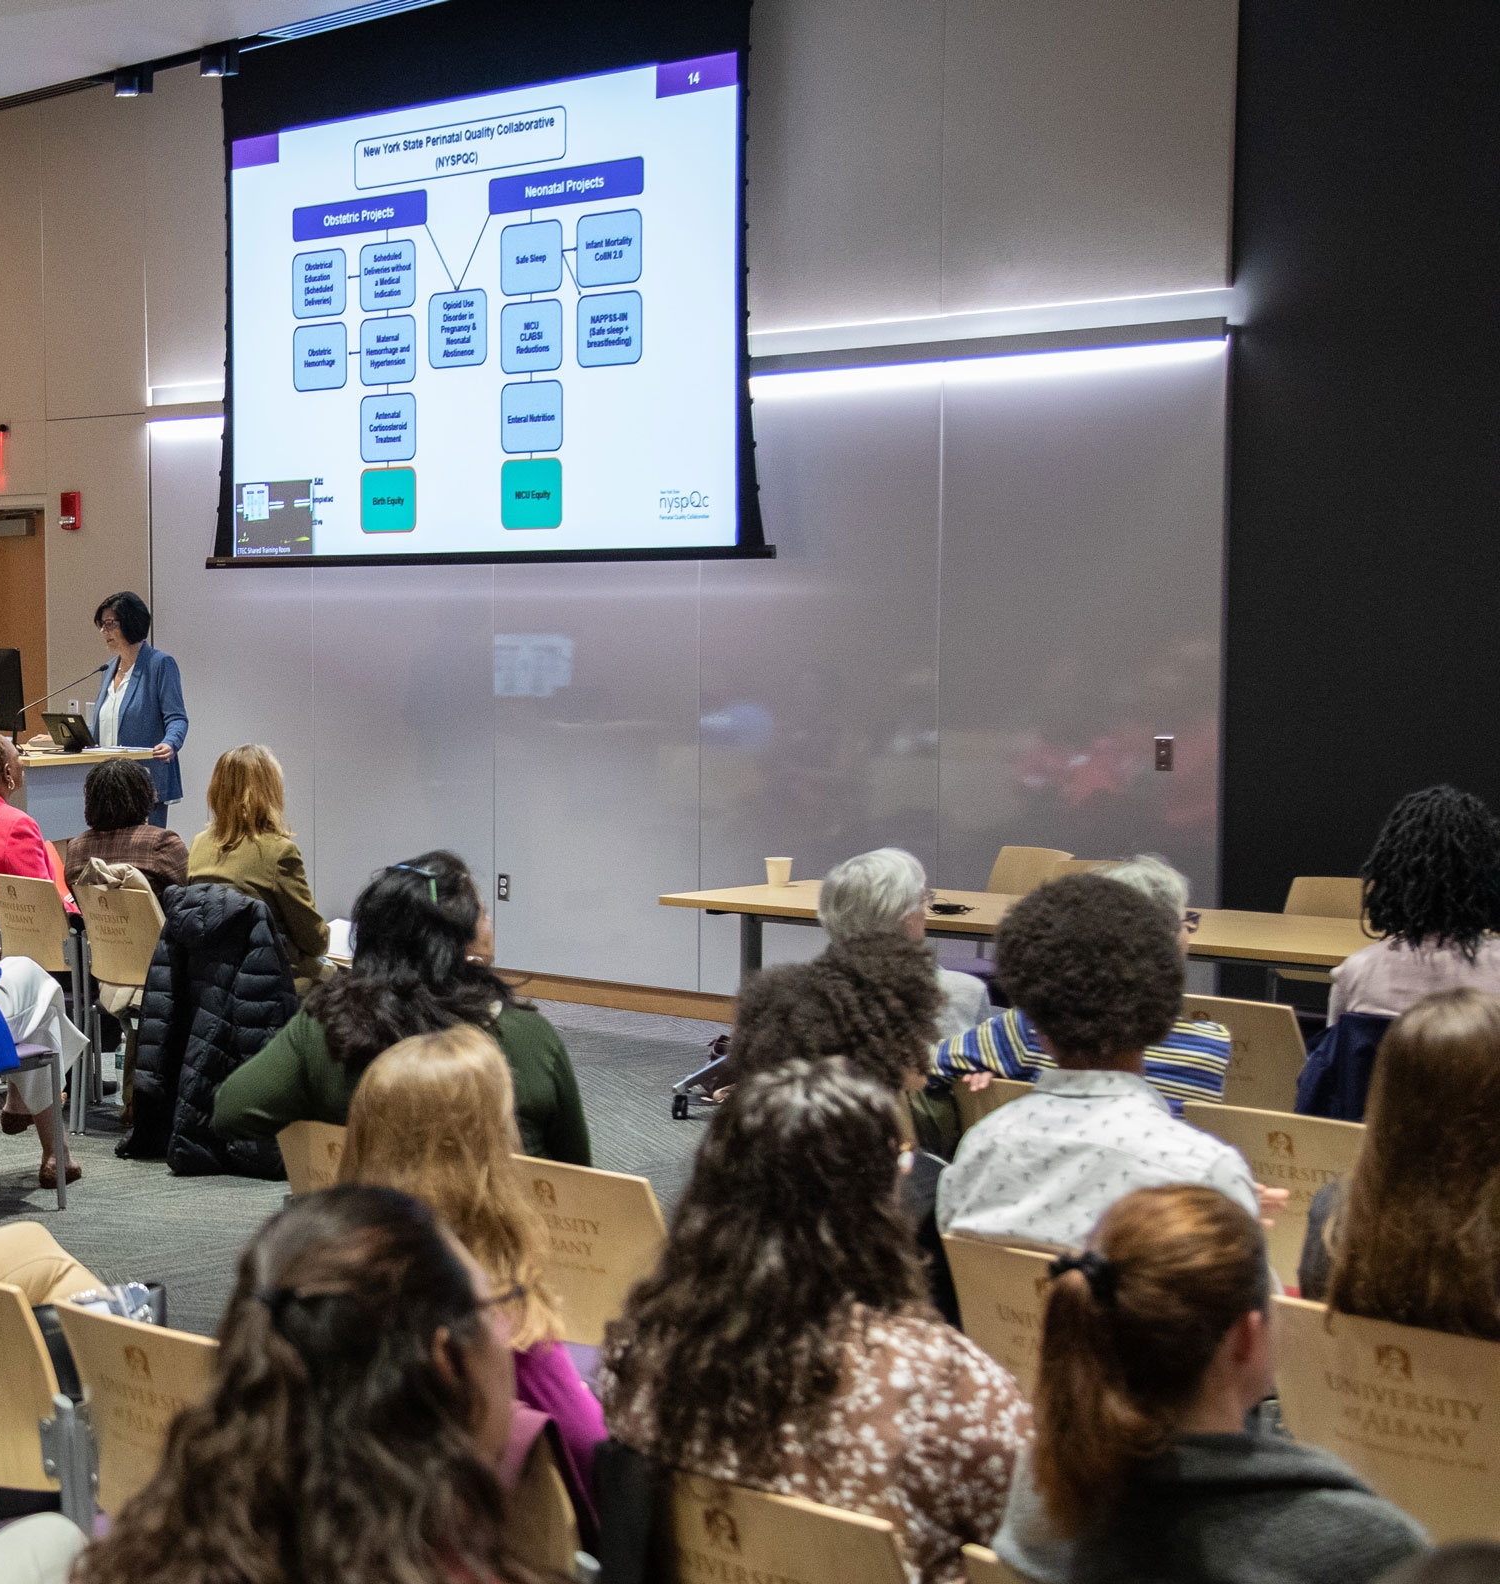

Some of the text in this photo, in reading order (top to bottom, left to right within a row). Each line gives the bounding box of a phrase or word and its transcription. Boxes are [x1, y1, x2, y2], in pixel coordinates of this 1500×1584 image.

[688, 71, 700, 86] 14
[363, 116, 555, 158] New York State Perinatal Quality Collaborative
[435, 151, 479, 171] (NYSPQC)
[524, 176, 605, 199] Neonatal Projects
[323, 206, 395, 227] Obstetric Projects
[585, 235, 633, 249] Infant Mortality
[373, 251, 402, 263] Scheduled
[515, 253, 547, 266] Safe Sleep
[613, 249, 624, 260] 2.0
[304, 260, 333, 272] Obstetrical
[363, 262, 412, 276] Deliveries without
[304, 273, 331, 284] Education
[375, 275, 401, 287] a Medical
[304, 284, 334, 297] (Scheduled
[374, 288, 402, 299] Indication
[304, 296, 332, 308] Deliveries)
[443, 299, 475, 311] Opioid Use
[443, 312, 475, 323] Disorder in
[440, 322, 477, 336] Pregnancy &
[523, 321, 540, 331] NICU
[589, 327, 605, 338] (Safe
[606, 325, 624, 337] sleep
[376, 333, 400, 344] Maternal
[445, 335, 471, 346] Neonatal
[519, 331, 543, 342] CLABSI
[586, 336, 632, 349] breastfeeding)
[307, 347, 332, 357] Obstetric
[366, 344, 410, 357] Hemorrhage and
[442, 348, 475, 359] Abstinence
[516, 344, 550, 355] Reductions
[304, 358, 336, 369] Hemorrhage
[370, 356, 406, 369] Hypertension
[375, 410, 401, 420] Antenatal
[507, 412, 556, 424] Enteral Nutrition
[369, 422, 408, 433] Corticosteroid
[375, 434, 402, 444] Treatment
[515, 489, 551, 501] NICU Equity
[372, 496, 405, 508] Birth Equity
[248, 546, 261, 554] Shared
[262, 546, 278, 555] Training
[88, 911, 131, 925] UNIVERSITY
[1323, 1370, 1485, 1422] UNIVERSITY
[1361, 1407, 1472, 1449] ALBANY
